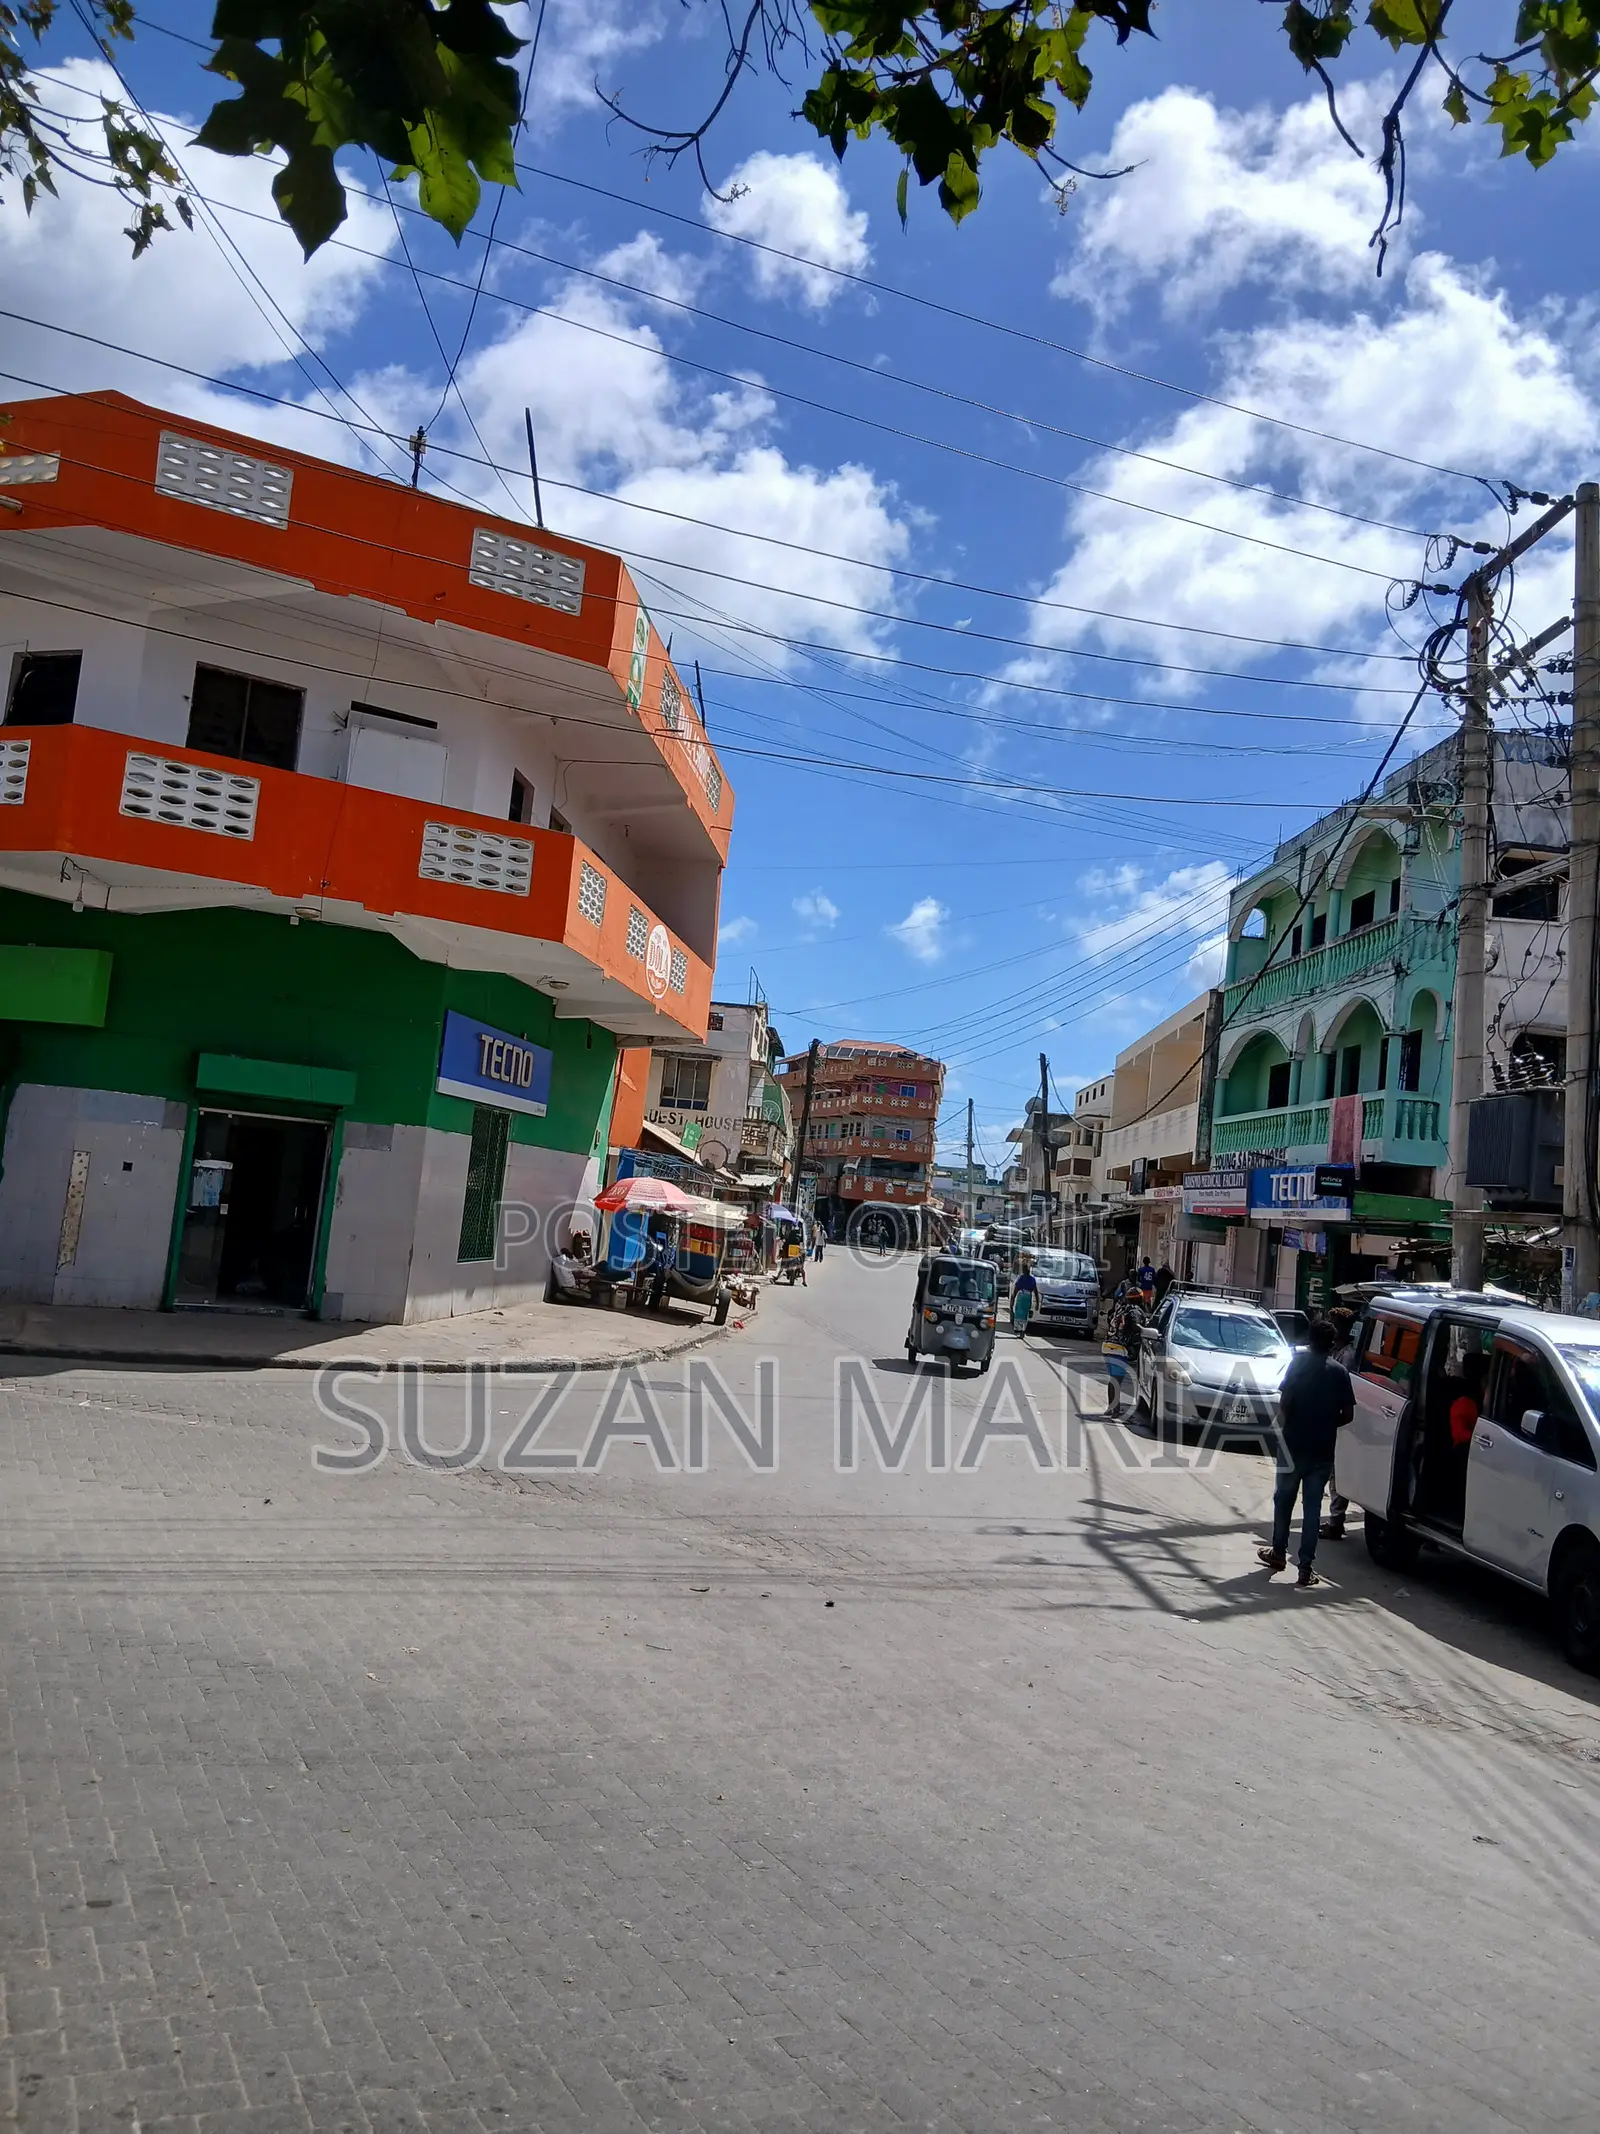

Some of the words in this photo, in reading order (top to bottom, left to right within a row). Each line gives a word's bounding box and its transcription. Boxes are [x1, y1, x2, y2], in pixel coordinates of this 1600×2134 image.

[480, 1033, 534, 1088] TECNO
[644, 1108, 684, 1126] UEST
[695, 1115, 744, 1132] HOUSE
[1223, 1172, 1245, 1187] FACILITY
[1143, 1271, 1153, 1281] 46
